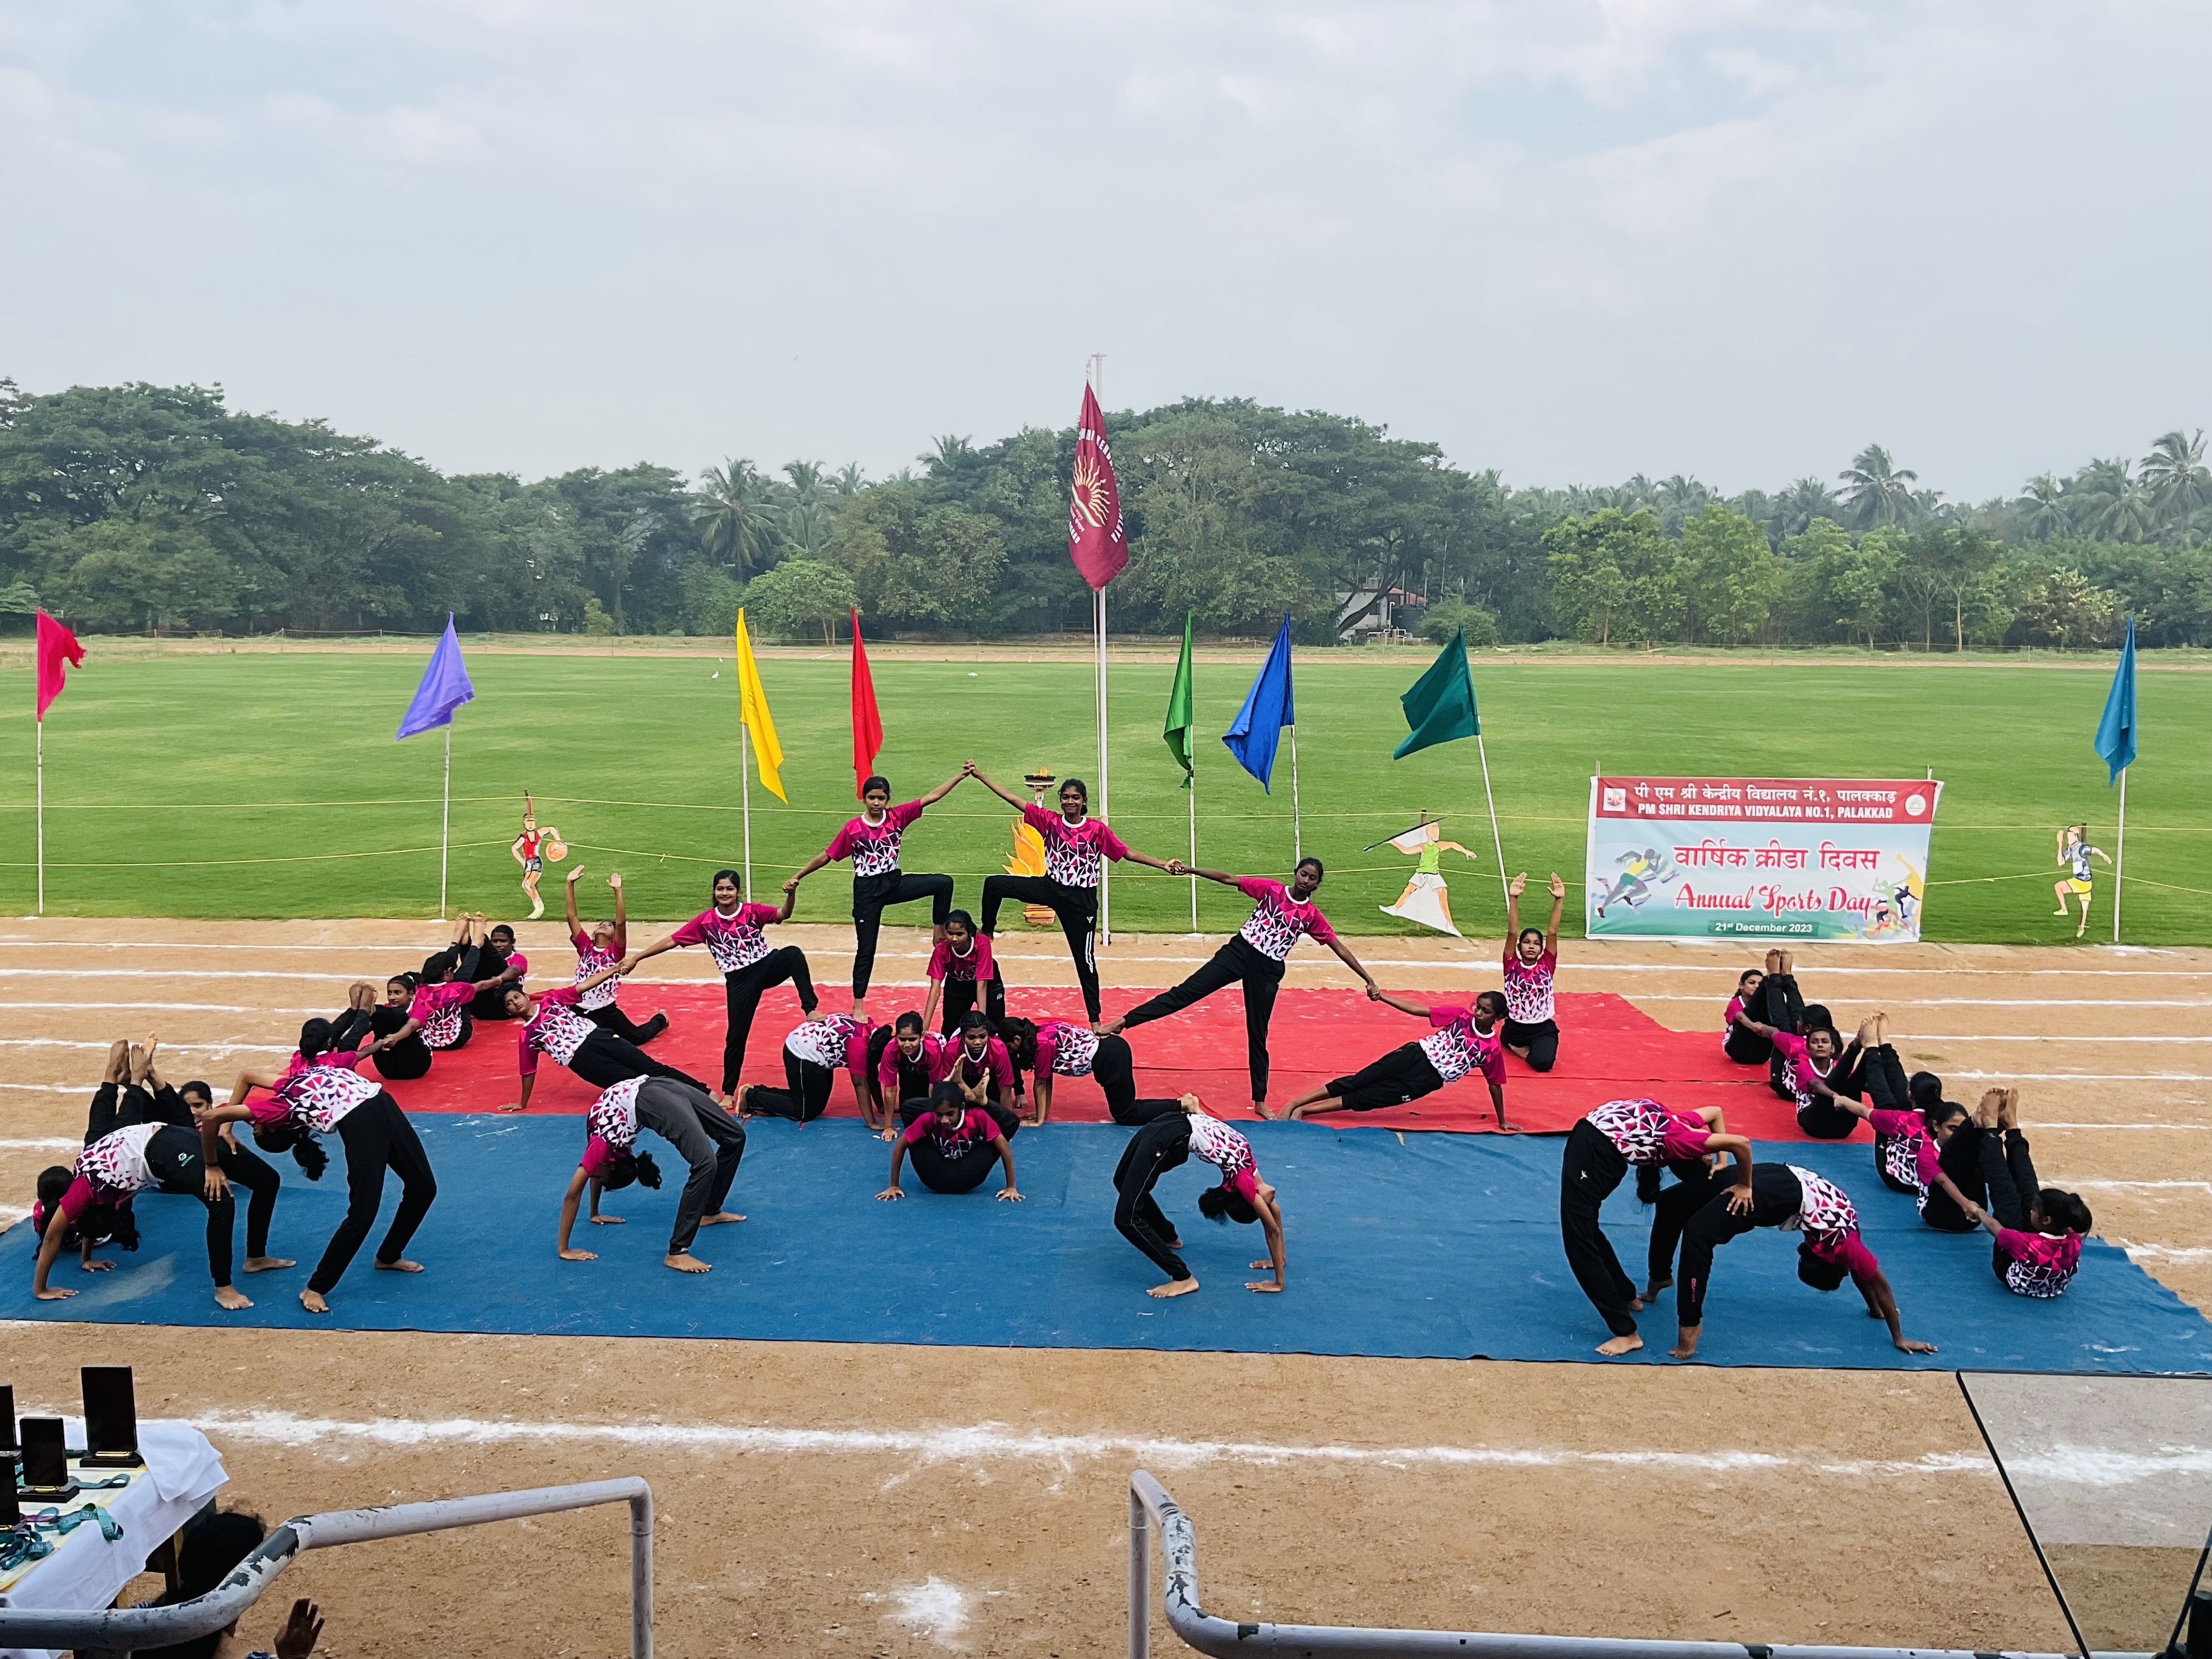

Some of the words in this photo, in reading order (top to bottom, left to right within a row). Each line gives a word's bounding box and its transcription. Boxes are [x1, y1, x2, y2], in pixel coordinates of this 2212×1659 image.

[1634, 782, 1650, 798] पी
[1654, 787, 1675, 801] एम
[1680, 783, 1698, 799] श्री
[1701, 783, 1742, 800] केन्द्रीय
[1746, 784, 1798, 801] विद्यालय
[1638, 803, 1656, 815] PM
[1658, 804, 1685, 815] SHRI
[1688, 804, 1742, 816] KENDRIYA
[1745, 805, 1802, 817] VIDYALAYA
[1805, 806, 1834, 820] NO.1,
[1837, 807, 1893, 819] PALAKKAD
[1673, 838, 1751, 867] वार्षिक
[1818, 841, 1881, 871] दिवस
[1675, 883, 1754, 910] Annual
[1758, 884, 1822, 918] Sports
[1825, 886, 1871, 920] Day
[1714, 923, 1734, 932] 21st
[1735, 923, 1787, 933] December
[1789, 924, 1813, 933] 2023
